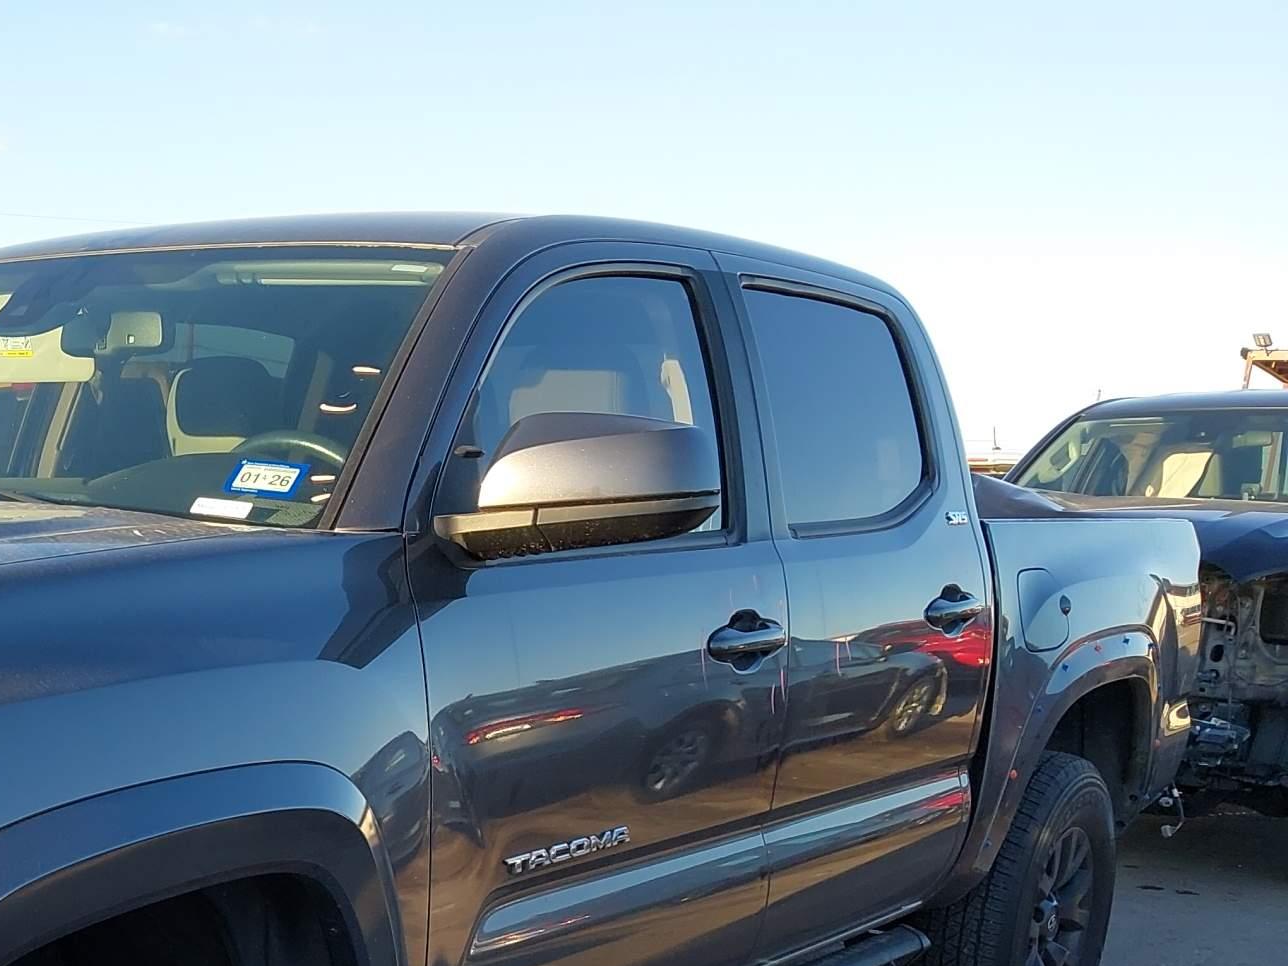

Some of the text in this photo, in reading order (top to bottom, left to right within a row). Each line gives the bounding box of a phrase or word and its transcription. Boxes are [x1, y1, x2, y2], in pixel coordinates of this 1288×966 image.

[240, 472, 292, 488] 01 26
[503, 825, 631, 873] TACOMA
